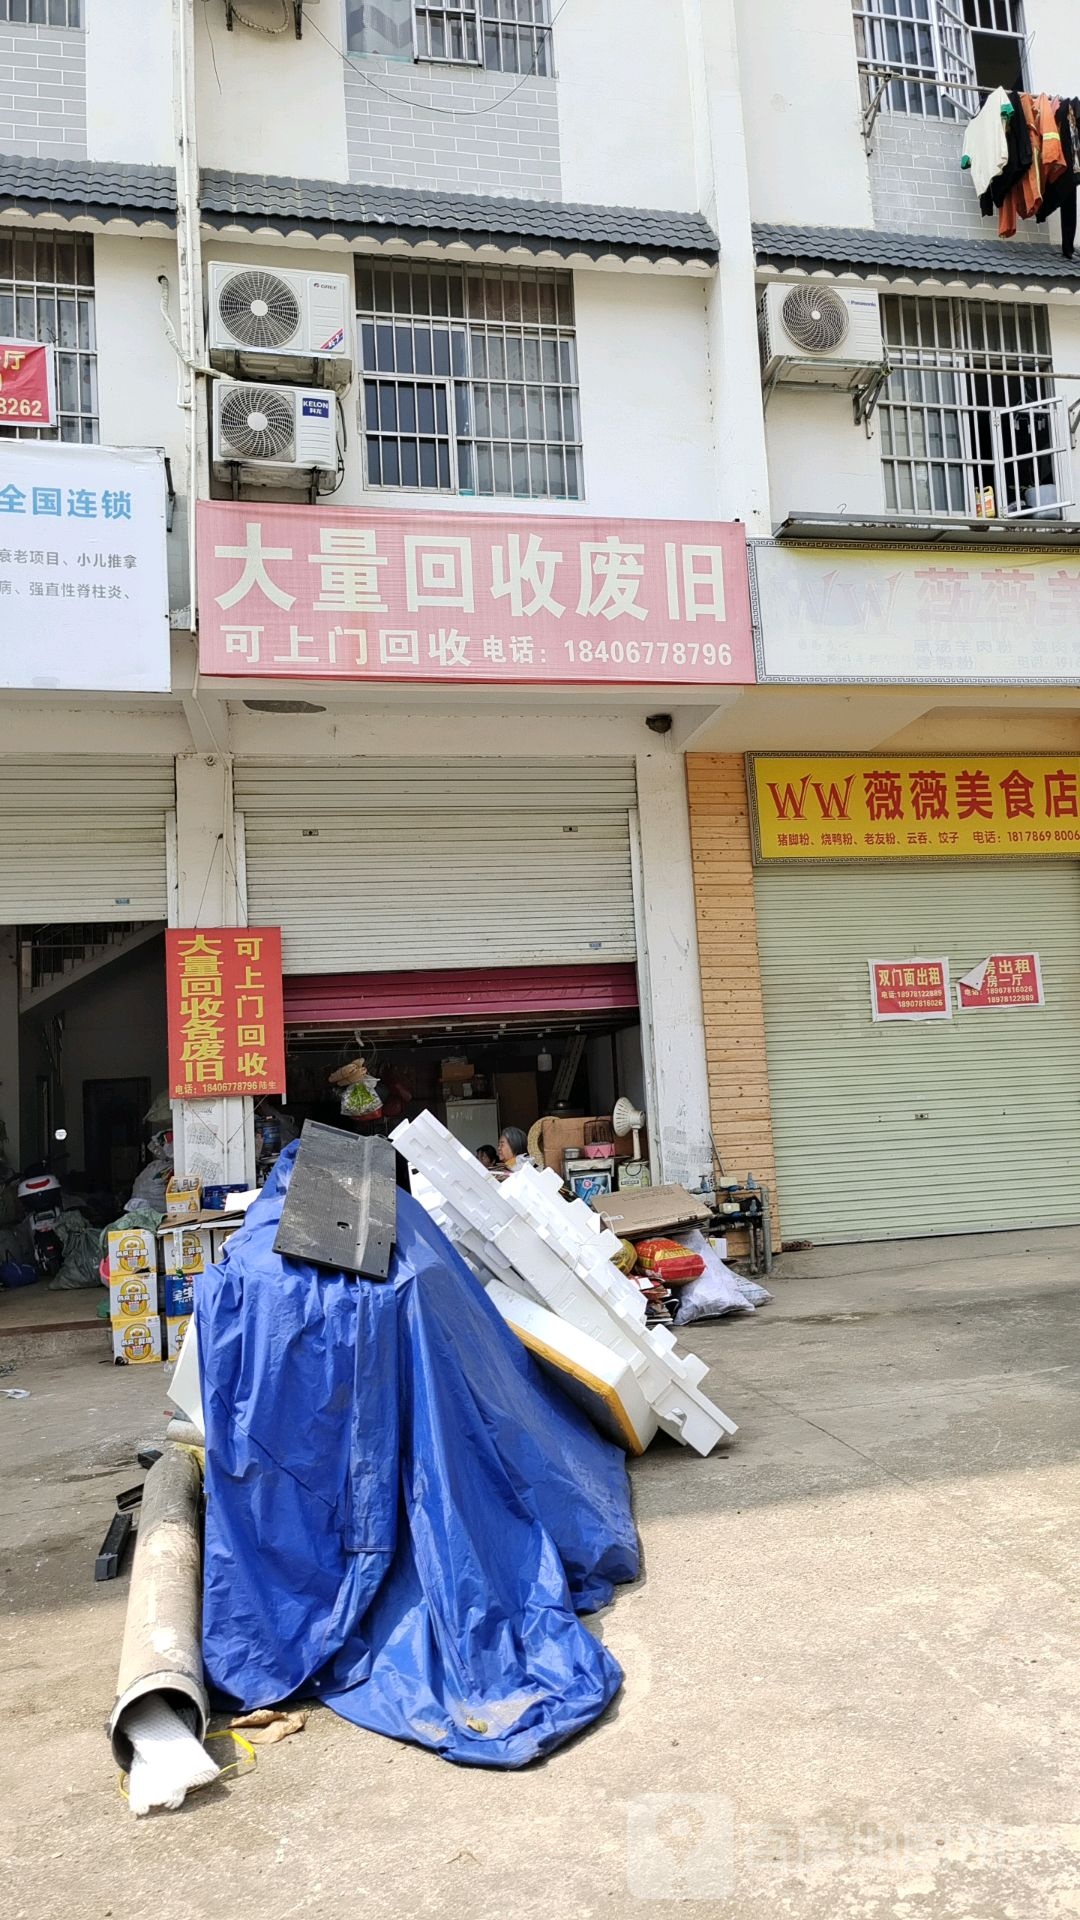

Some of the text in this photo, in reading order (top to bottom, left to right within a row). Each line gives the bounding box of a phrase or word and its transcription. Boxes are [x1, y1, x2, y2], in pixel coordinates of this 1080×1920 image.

[303, 400, 329, 409] KELON
[0, 483, 133, 520] 全国连锁
[213, 522, 727, 623] 大量回收废旧
[219, 625, 472, 667] 可上门回收
[563, 639, 733, 666] 18406778796
[862, 769, 1079, 821] 薇薇美食店
[877, 967, 942, 987] 双门面出租
[178, 934, 225, 1082] 大量回收各废旧
[234, 938, 268, 1077] 可上门回收
[203, 1081, 258, 1093] 18406778796
